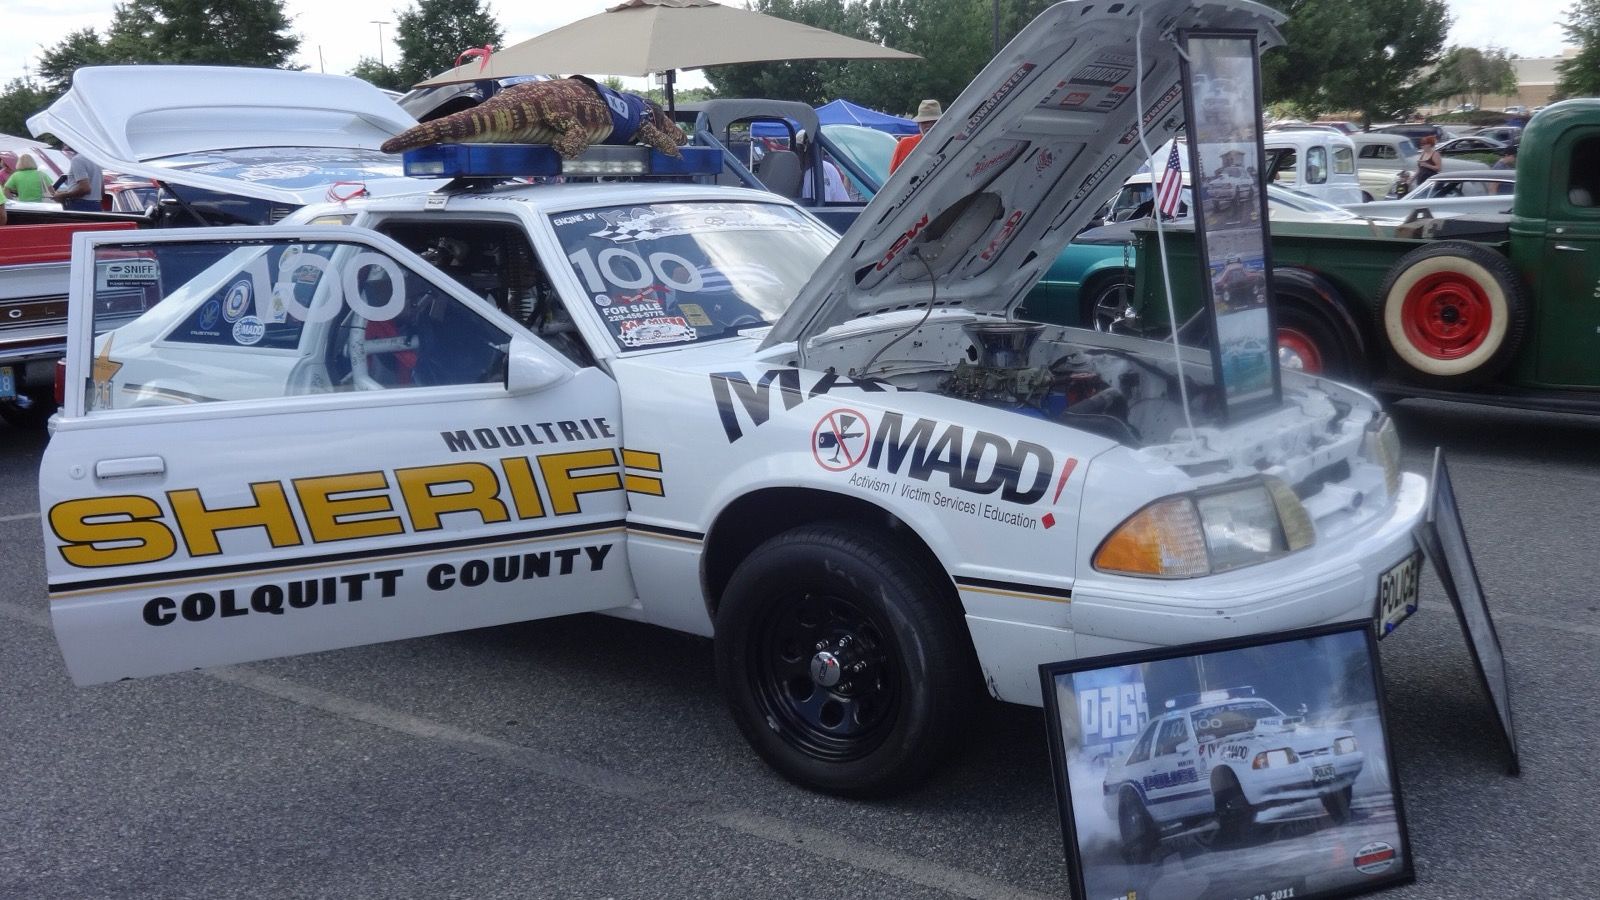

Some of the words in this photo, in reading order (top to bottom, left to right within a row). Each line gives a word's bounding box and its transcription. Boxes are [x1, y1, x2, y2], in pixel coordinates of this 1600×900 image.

[963, 67, 1027, 137] FLOWMASTER
[553, 215, 584, 227] ENGINE
[583, 212, 597, 221] BY
[124, 265, 154, 274] SNIFF
[243, 252, 406, 324] 100
[568, 247, 704, 293] 100
[602, 305, 629, 316] FOR
[630, 302, 663, 313] SALE
[441, 417, 615, 453] MOULTRIE
[48, 446, 665, 568] SHERIFF
[848, 472, 890, 495] Activism
[901, 483, 931, 503] Victim
[934, 491, 976, 514] Services
[983, 504, 1037, 530] Education
[142, 565, 404, 627] COLQUITT
[426, 543, 613, 591] COUNTY
[1382, 560, 1416, 614] POLICE
[1271, 887, 1294, 900] 2011
